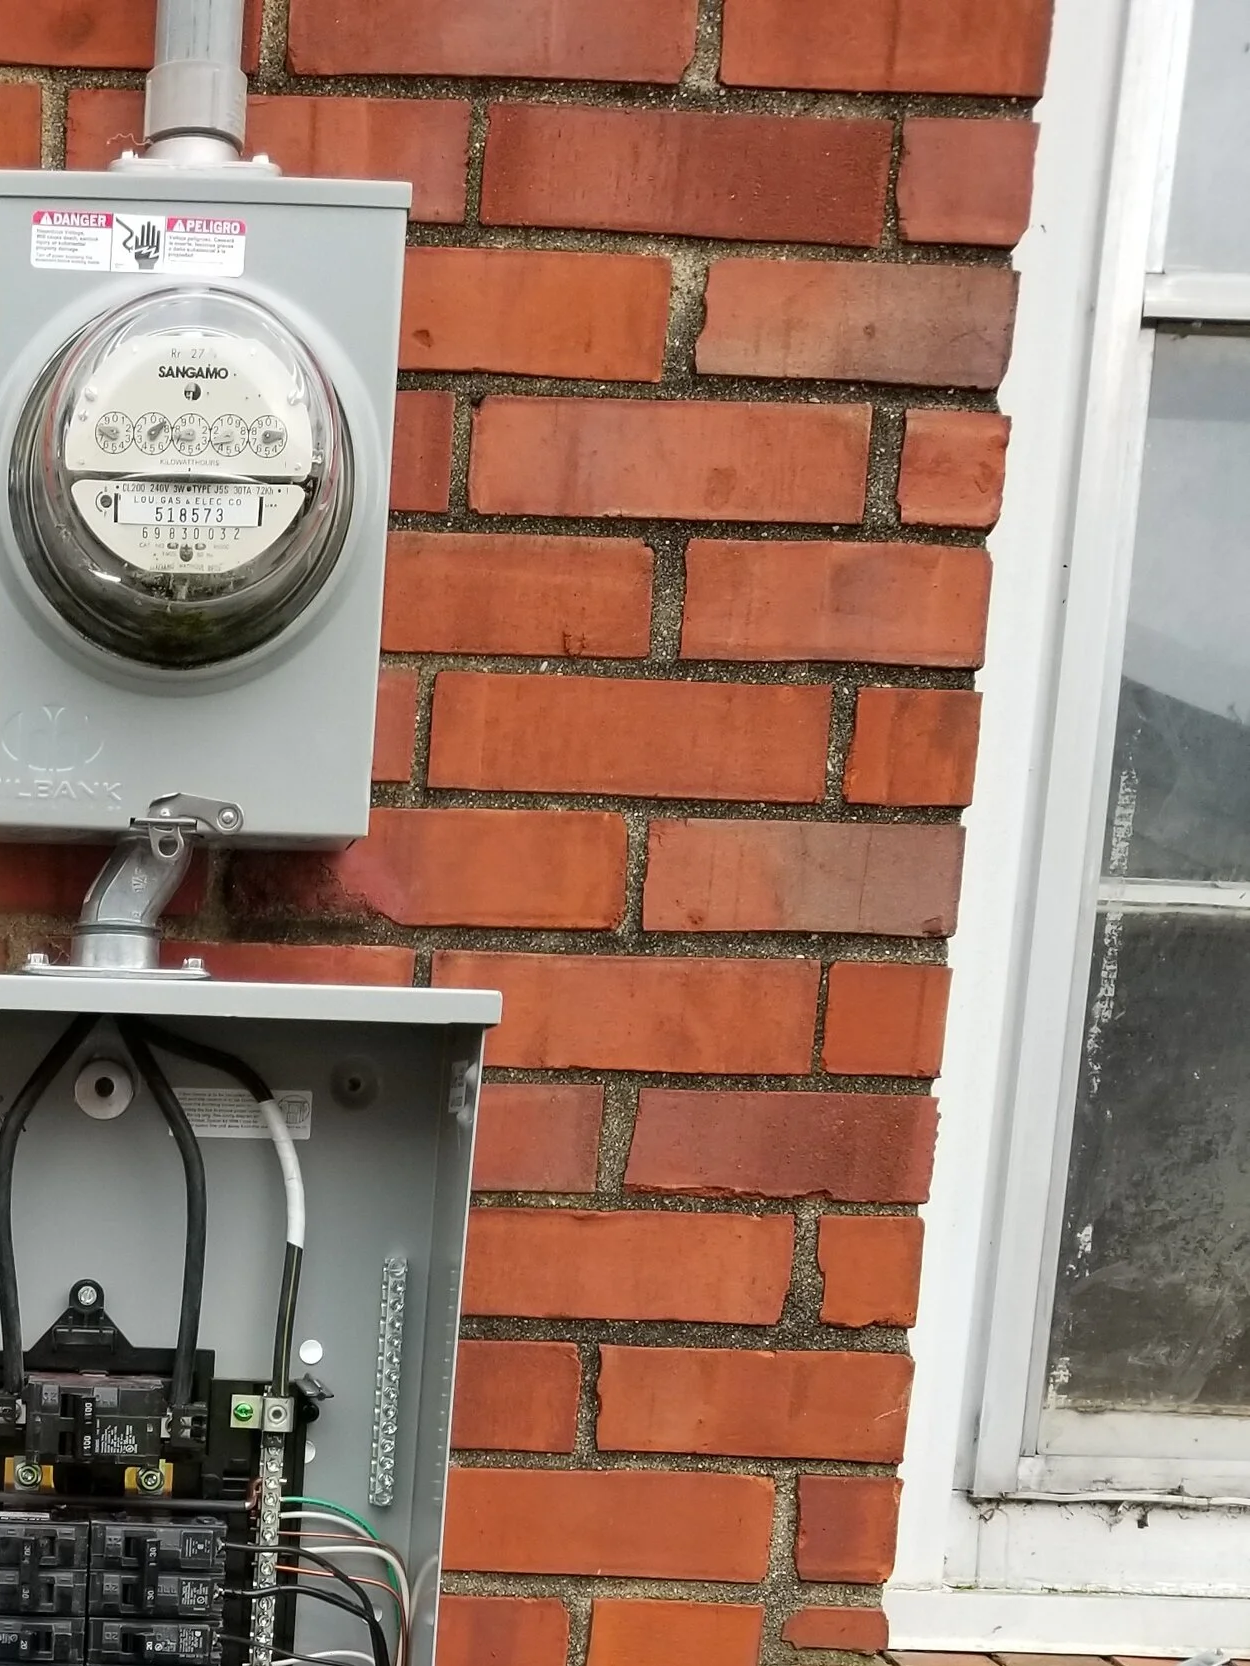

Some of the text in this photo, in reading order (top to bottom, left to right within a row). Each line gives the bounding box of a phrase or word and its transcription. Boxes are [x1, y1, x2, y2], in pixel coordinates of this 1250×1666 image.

[54, 213, 106, 226] DANGER
[187, 221, 240, 233] PELIGRO
[192, 349, 205, 358] 27
[159, 366, 228, 379] SANGAMO
[160, 459, 220, 467] KILOWATTHOURS
[150, 485, 169, 493] 240V
[174, 485, 185, 493] 3W
[193, 485, 210, 494] TYPE
[155, 507, 224, 523] 518573
[83, 1435, 91, 1450] 100
[150, 1547, 157, 1557] 30
[22, 1588, 29, 1598] 30
[147, 1590, 154, 1600] 30
[20, 1640, 28, 1650] 20
